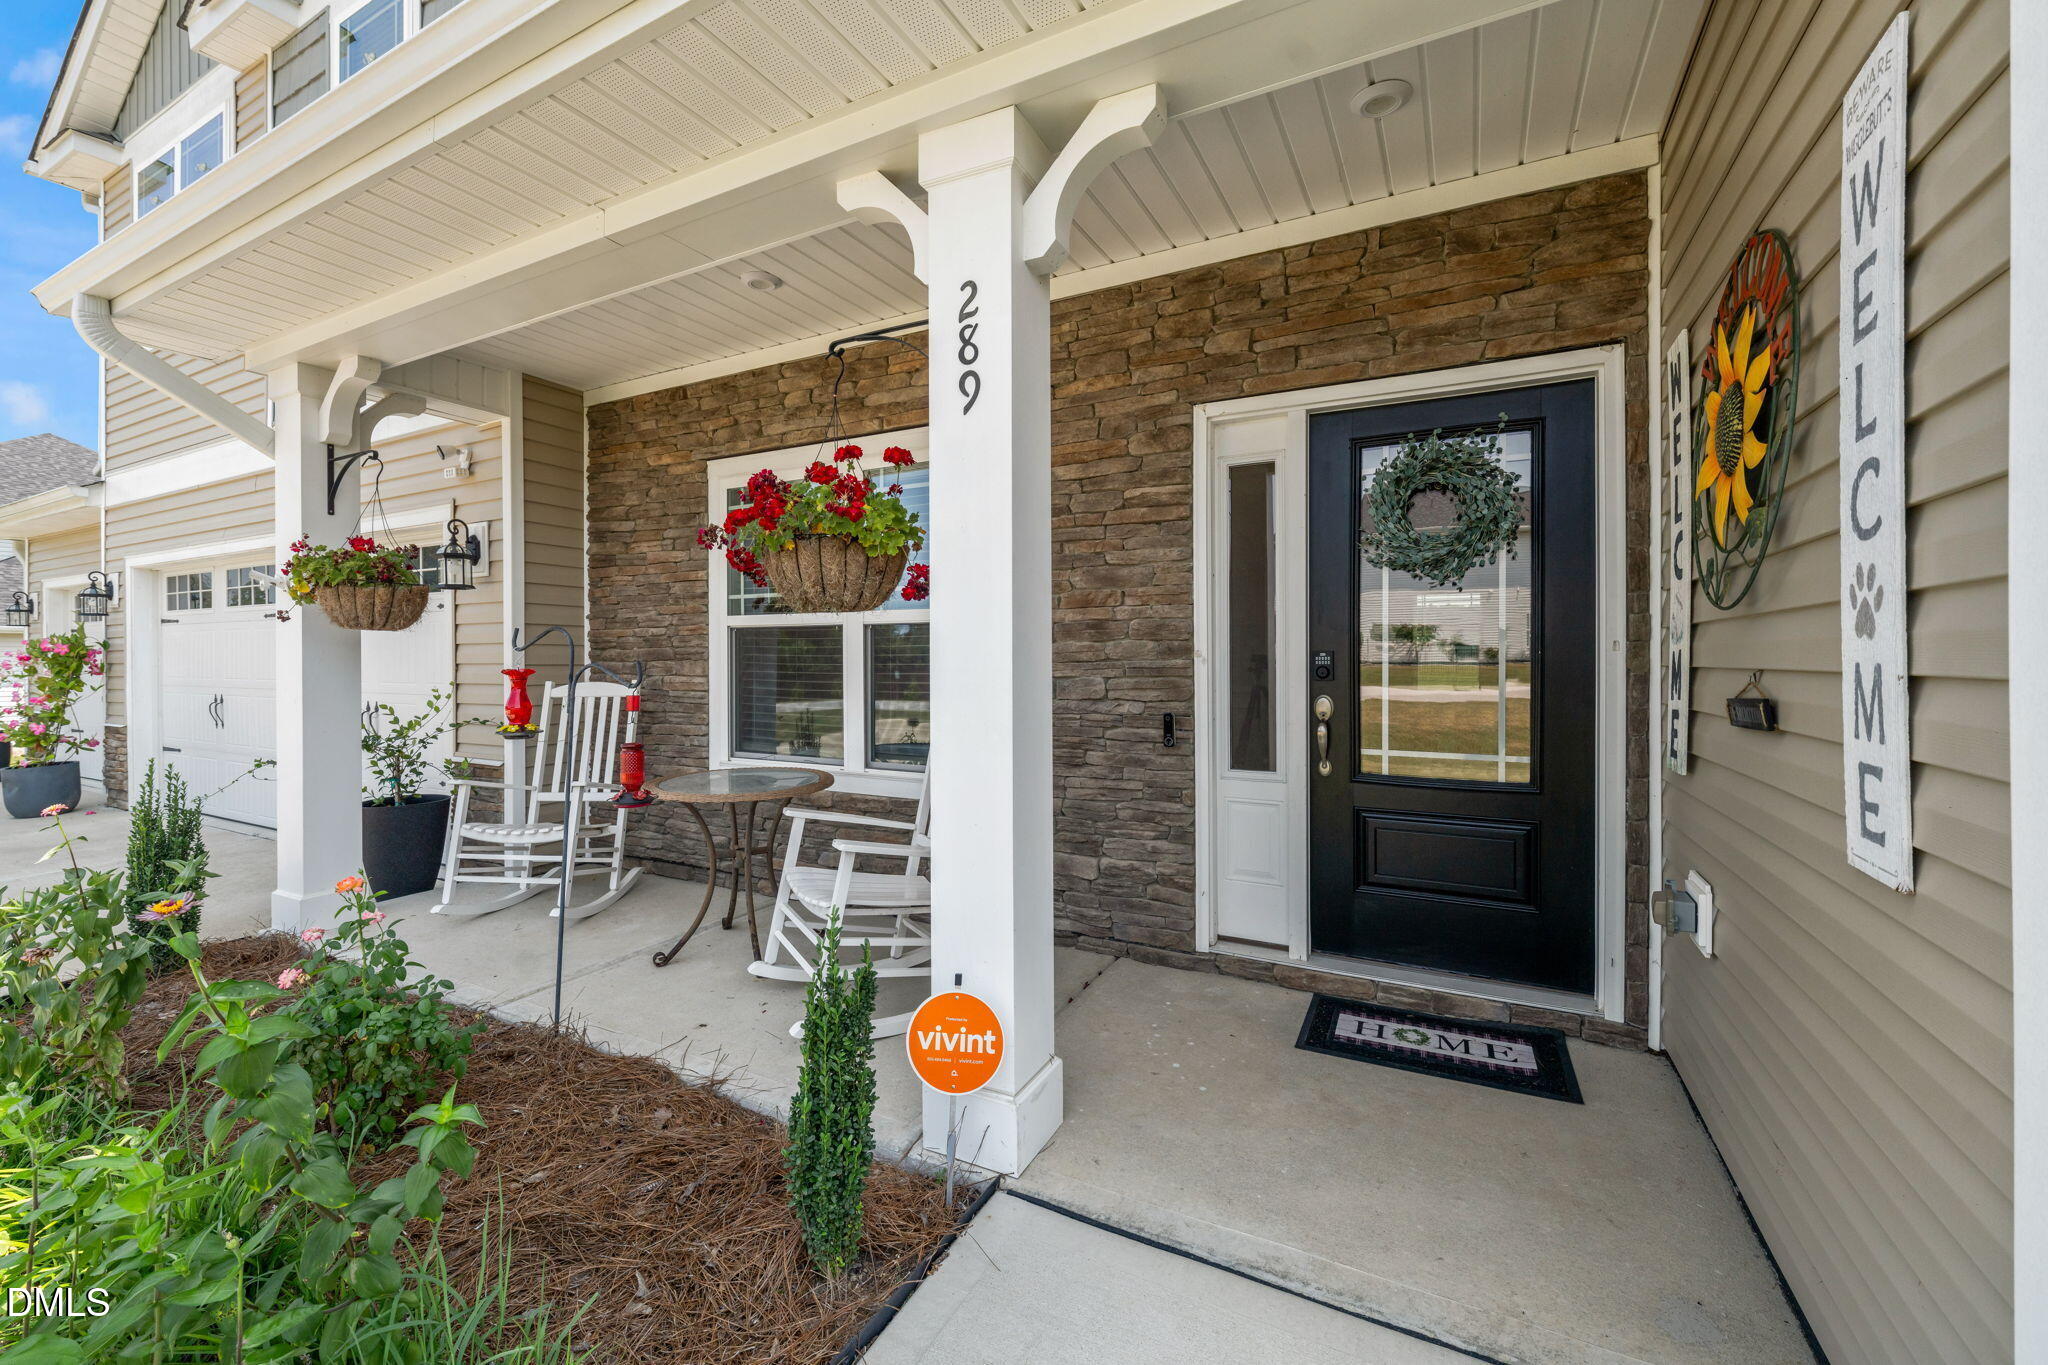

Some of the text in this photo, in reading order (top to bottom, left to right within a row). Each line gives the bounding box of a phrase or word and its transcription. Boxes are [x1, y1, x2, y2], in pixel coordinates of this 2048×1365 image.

[1846, 48, 1893, 128] BEWARE
[958, 279, 981, 416] 289
[917, 1025, 996, 1055] vivint
